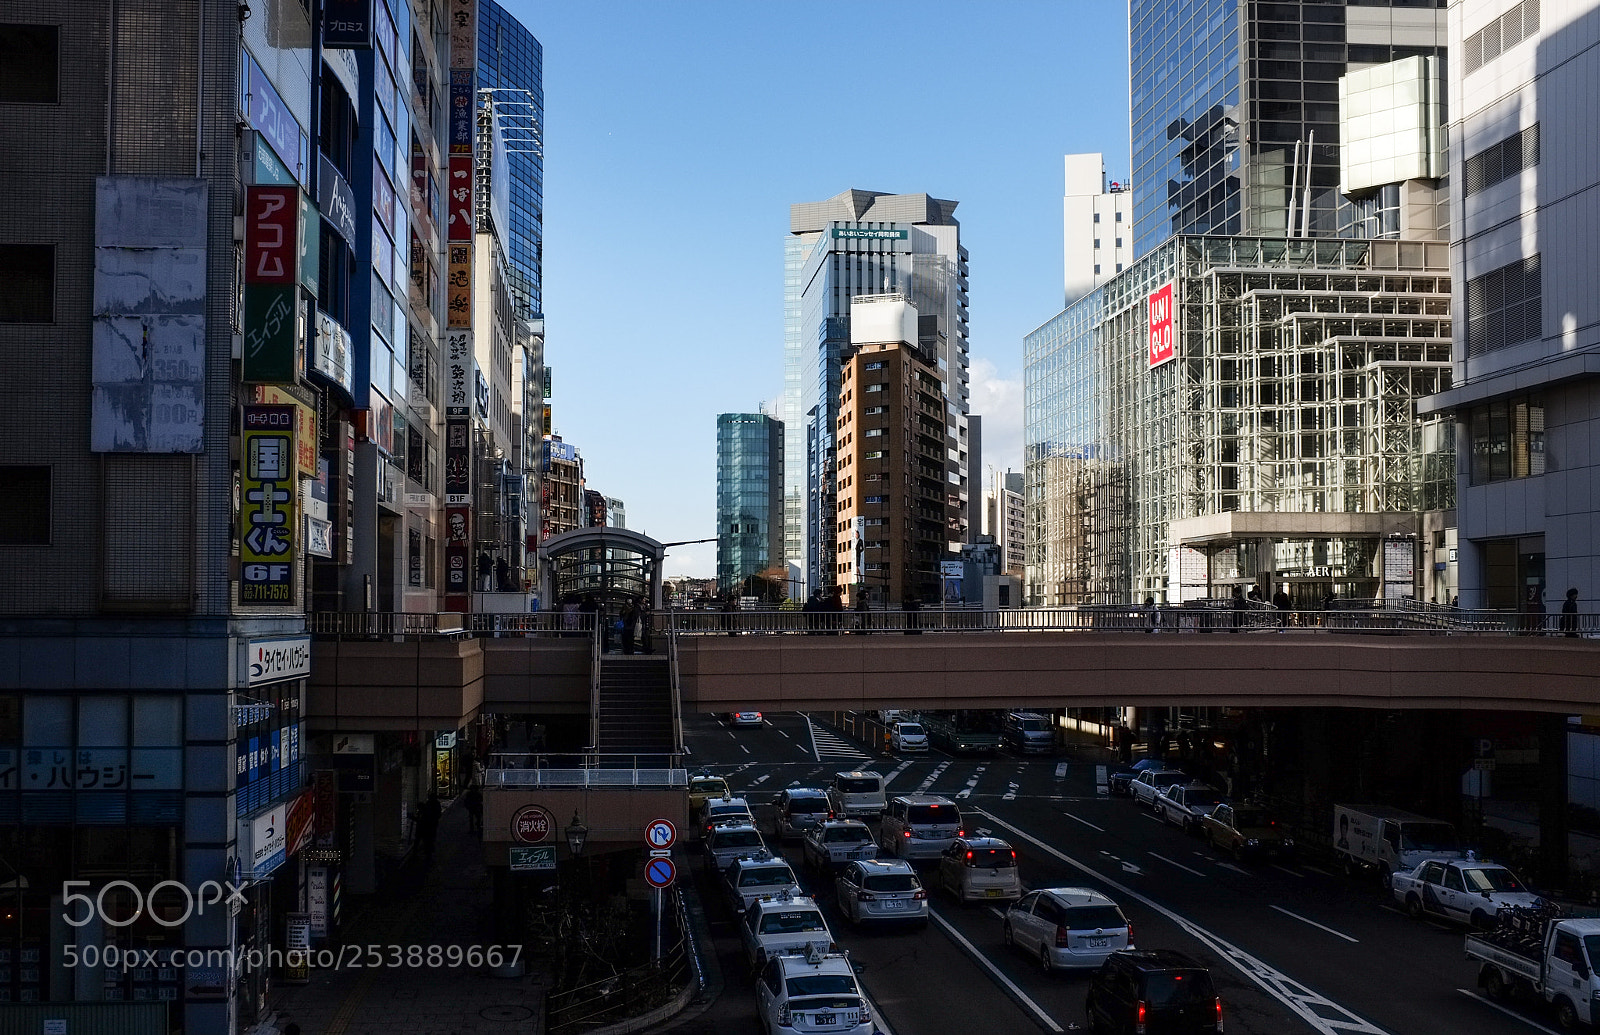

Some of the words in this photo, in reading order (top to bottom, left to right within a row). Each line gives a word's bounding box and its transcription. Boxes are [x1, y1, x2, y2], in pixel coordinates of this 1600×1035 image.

[329, 19, 364, 32] プロミス
[259, 87, 285, 150] アコム
[257, 194, 285, 277] アコム
[1152, 295, 1169, 325] UNI
[247, 293, 291, 358] エイブル
[1152, 325, 1170, 358] QLO
[244, 564, 289, 580] 6F
[1308, 566, 1330, 577] AER
[265, 645, 309, 673] タイセイ・ハウジー
[519, 820, 547, 833] 消火栓
[518, 849, 549, 863] エイブル
[847, 1012, 858, 1020] 111
